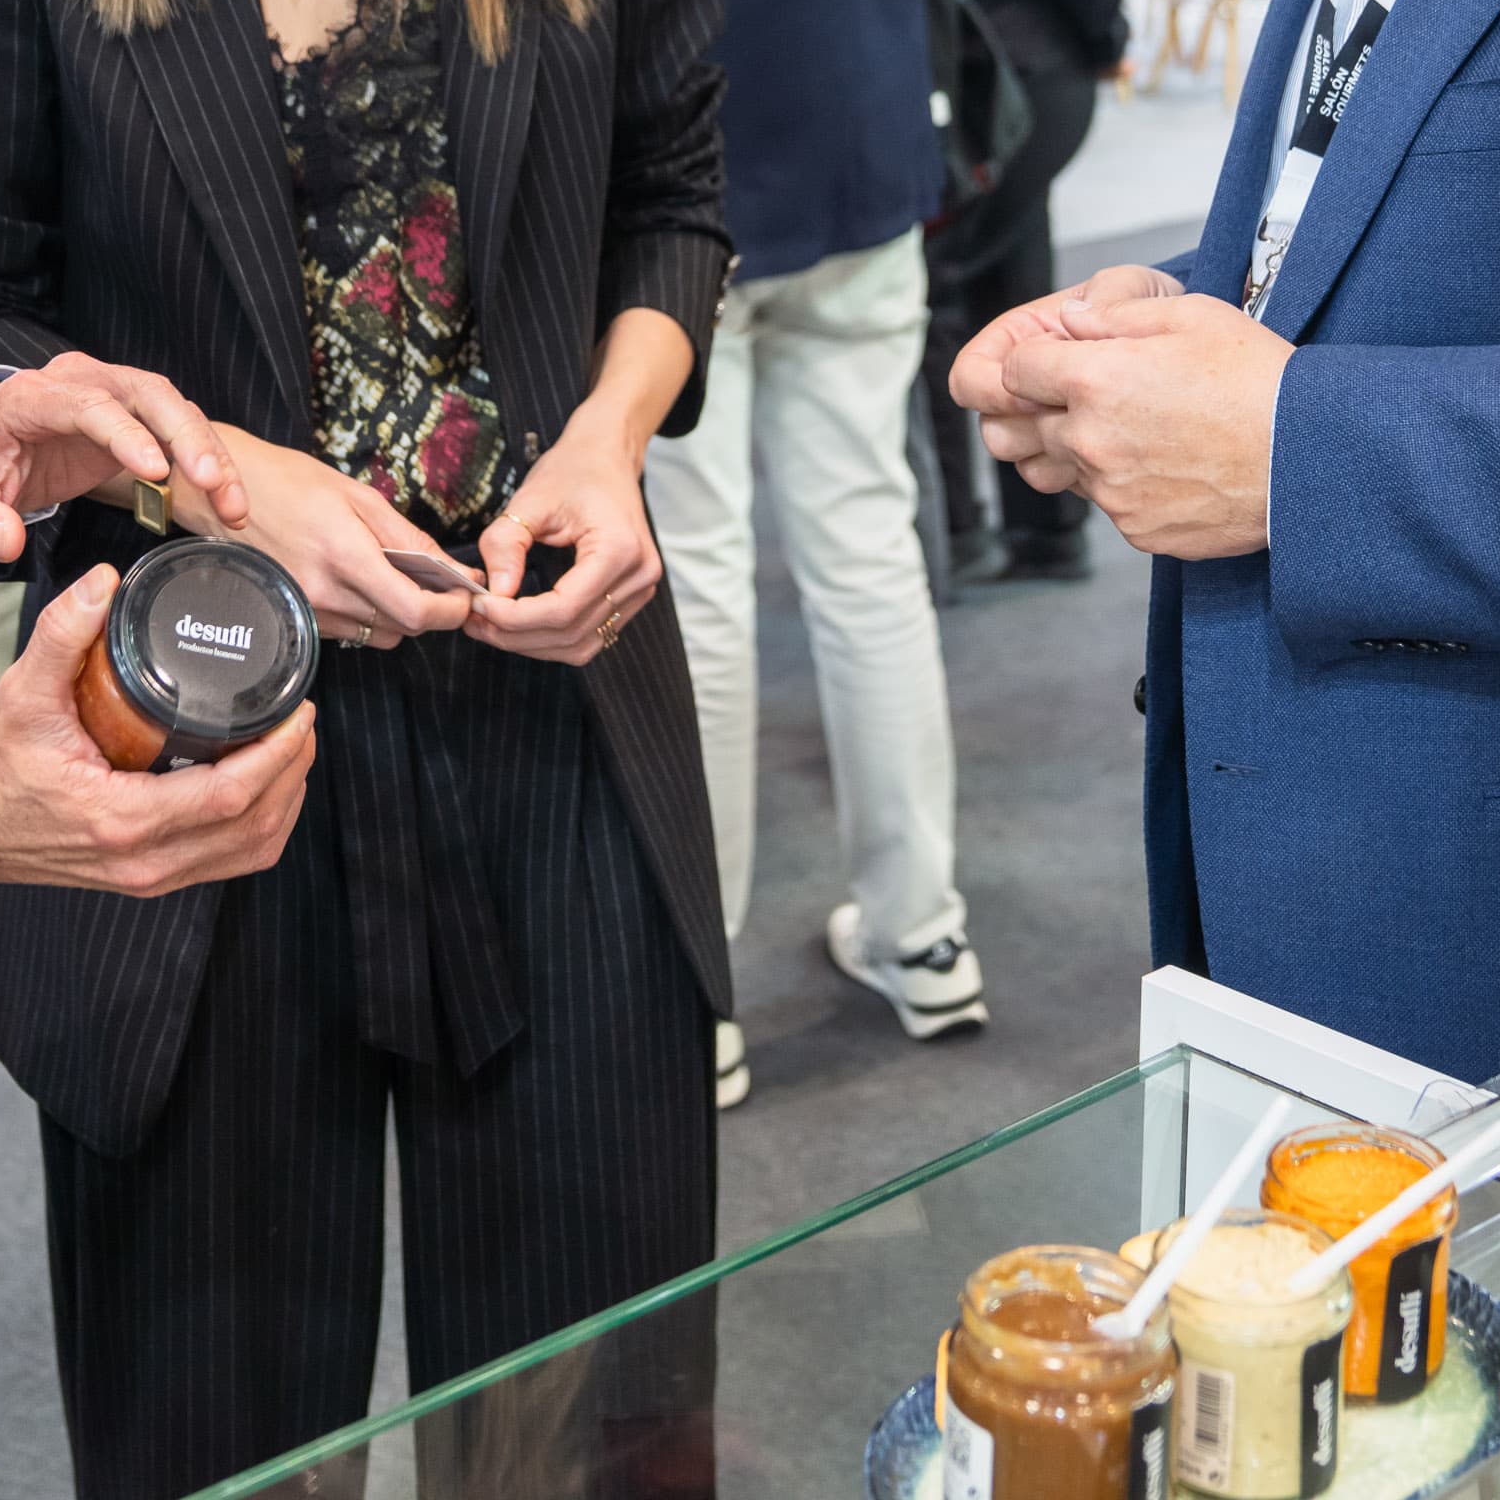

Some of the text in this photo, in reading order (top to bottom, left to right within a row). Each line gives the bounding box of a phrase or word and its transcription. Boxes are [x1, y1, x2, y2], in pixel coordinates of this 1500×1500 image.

[1319, 66, 1350, 117] SALÓN
[175, 613, 254, 650] desuflí
[1394, 1288, 1423, 1375] desuflí
